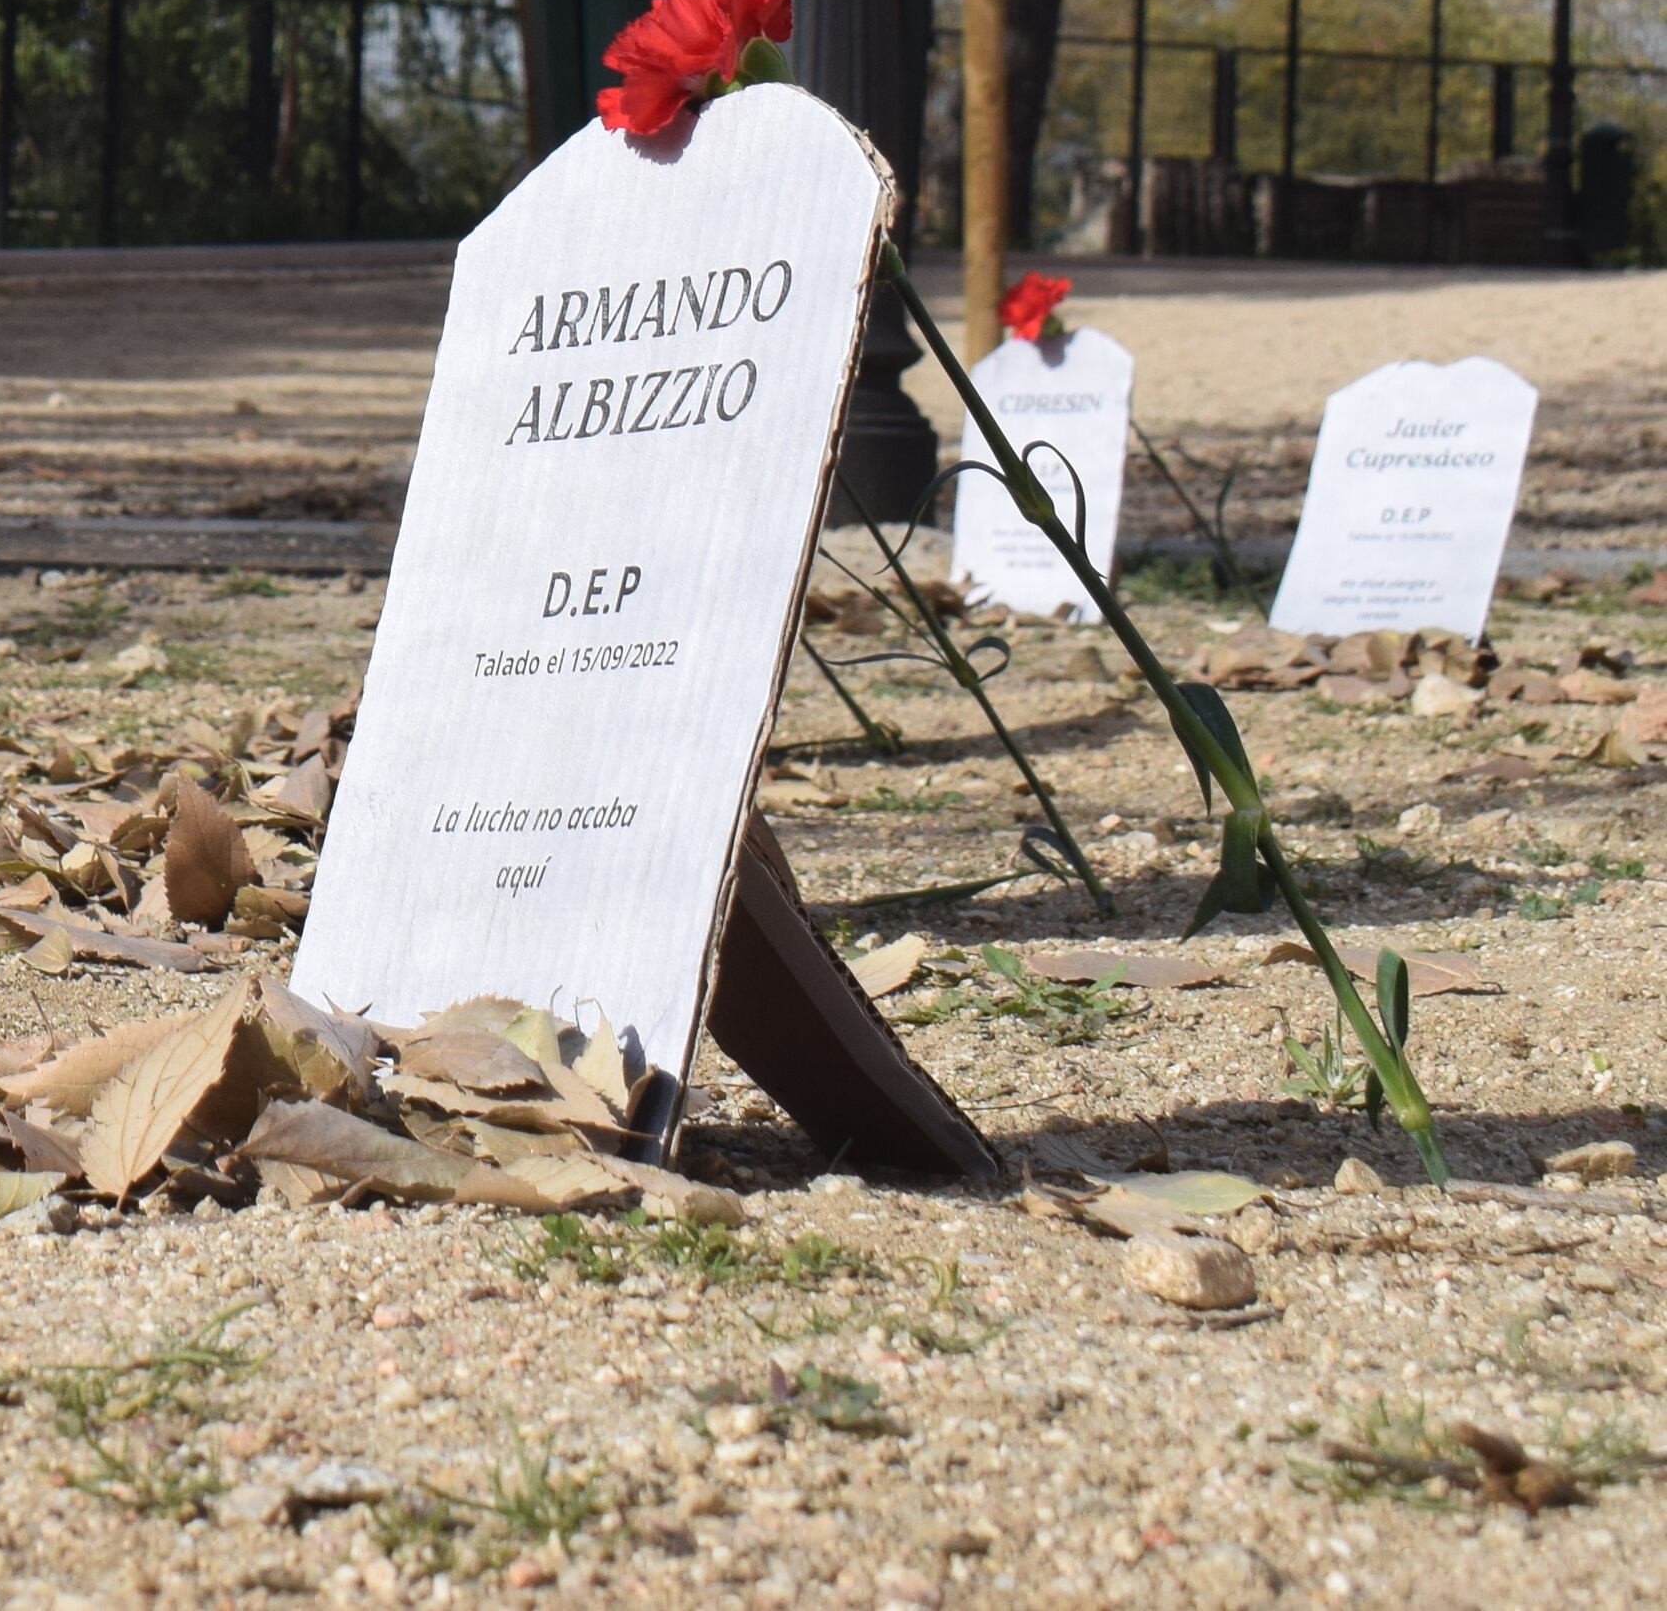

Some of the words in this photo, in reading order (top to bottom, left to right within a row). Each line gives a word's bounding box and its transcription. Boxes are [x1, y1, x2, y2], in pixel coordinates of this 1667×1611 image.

[508, 259, 792, 355] ARMANDO
[505, 358, 757, 446] ALBIZZIO
[1385, 417, 1468, 439] Javier
[1345, 446, 1495, 474] Cupresáceo
[542, 565, 642, 618] D.E.P
[474, 649, 540, 677] Talado
[546, 647, 566, 674] el
[571, 640, 679, 672] 15/09/2022
[432, 803, 461, 833] La
[464, 801, 531, 832] lucha
[532, 806, 563, 831] no
[567, 796, 638, 830] acaba
[496, 856, 552, 899] aquí
